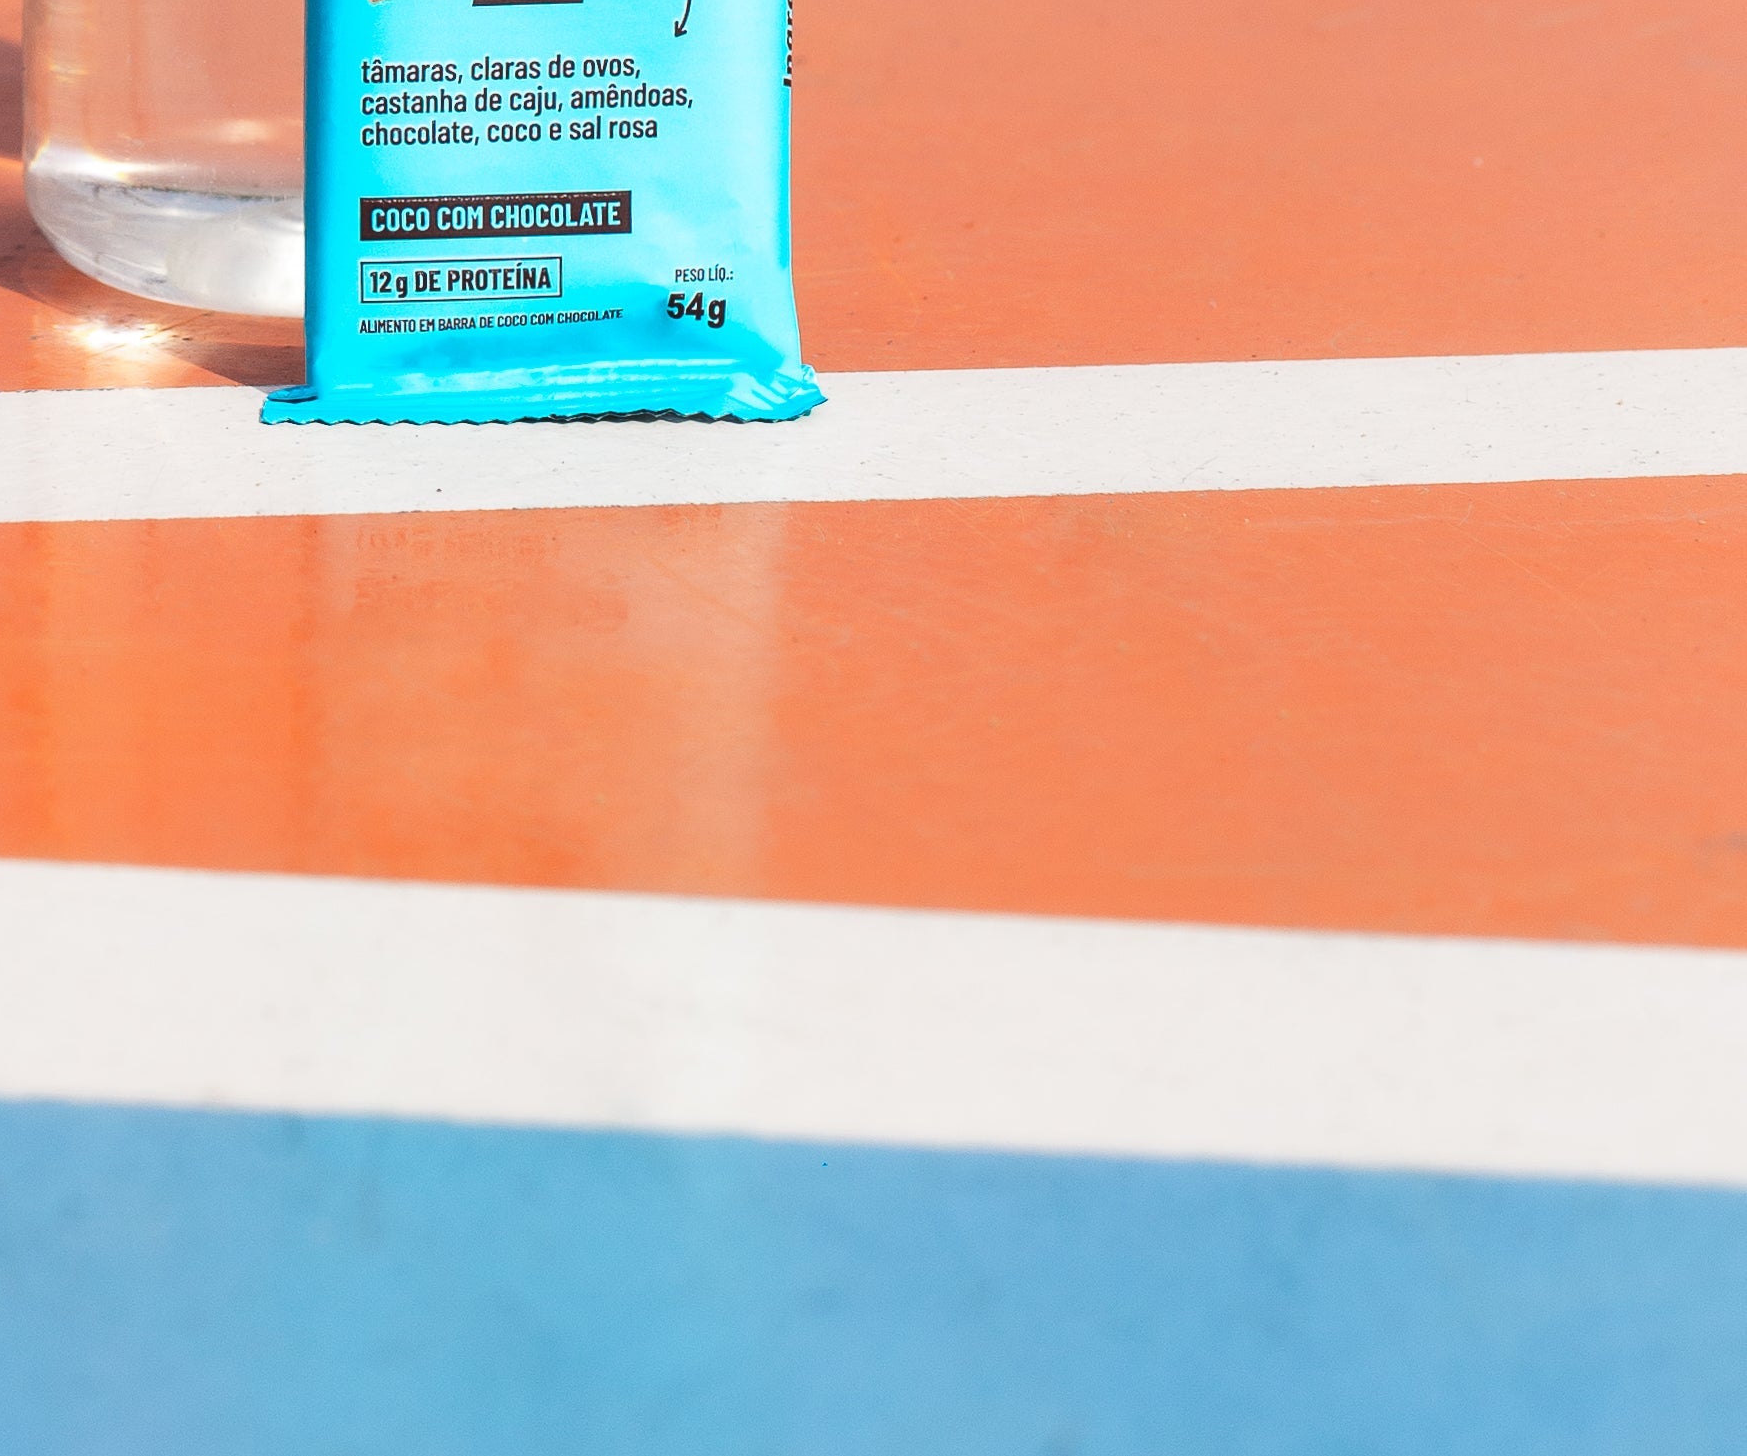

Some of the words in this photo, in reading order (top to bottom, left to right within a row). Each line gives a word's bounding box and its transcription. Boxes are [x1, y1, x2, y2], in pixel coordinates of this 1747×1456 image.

[361, 58, 463, 84] tâmaras,
[472, 56, 540, 80] claras
[549, 54, 575, 78] de
[584, 59, 640, 78] ovos,
[363, 89, 466, 114] castanha
[475, 88, 501, 111] de
[510, 86, 562, 116] caju,
[571, 83, 692, 109] amêndoas,
[362, 121, 478, 146] chocolate,
[488, 124, 541, 142] coco
[550, 123, 561, 140] e
[570, 116, 601, 140] sal
[610, 120, 657, 138] rosa
[372, 208, 429, 232] COCO
[437, 206, 483, 230] COM
[491, 202, 620, 228] CHOCOLATE
[415, 271, 440, 292] DE
[447, 262, 552, 292] PROTEÍNA
[675, 268, 705, 283] PESO
[360, 320, 415, 333] ALIMENTO
[420, 319, 434, 332] EM
[439, 318, 476, 331] BARRA
[480, 317, 493, 328] DE
[498, 315, 527, 327] COCO
[531, 314, 553, 325] COM
[558, 310, 622, 323] CHOCOLATE
